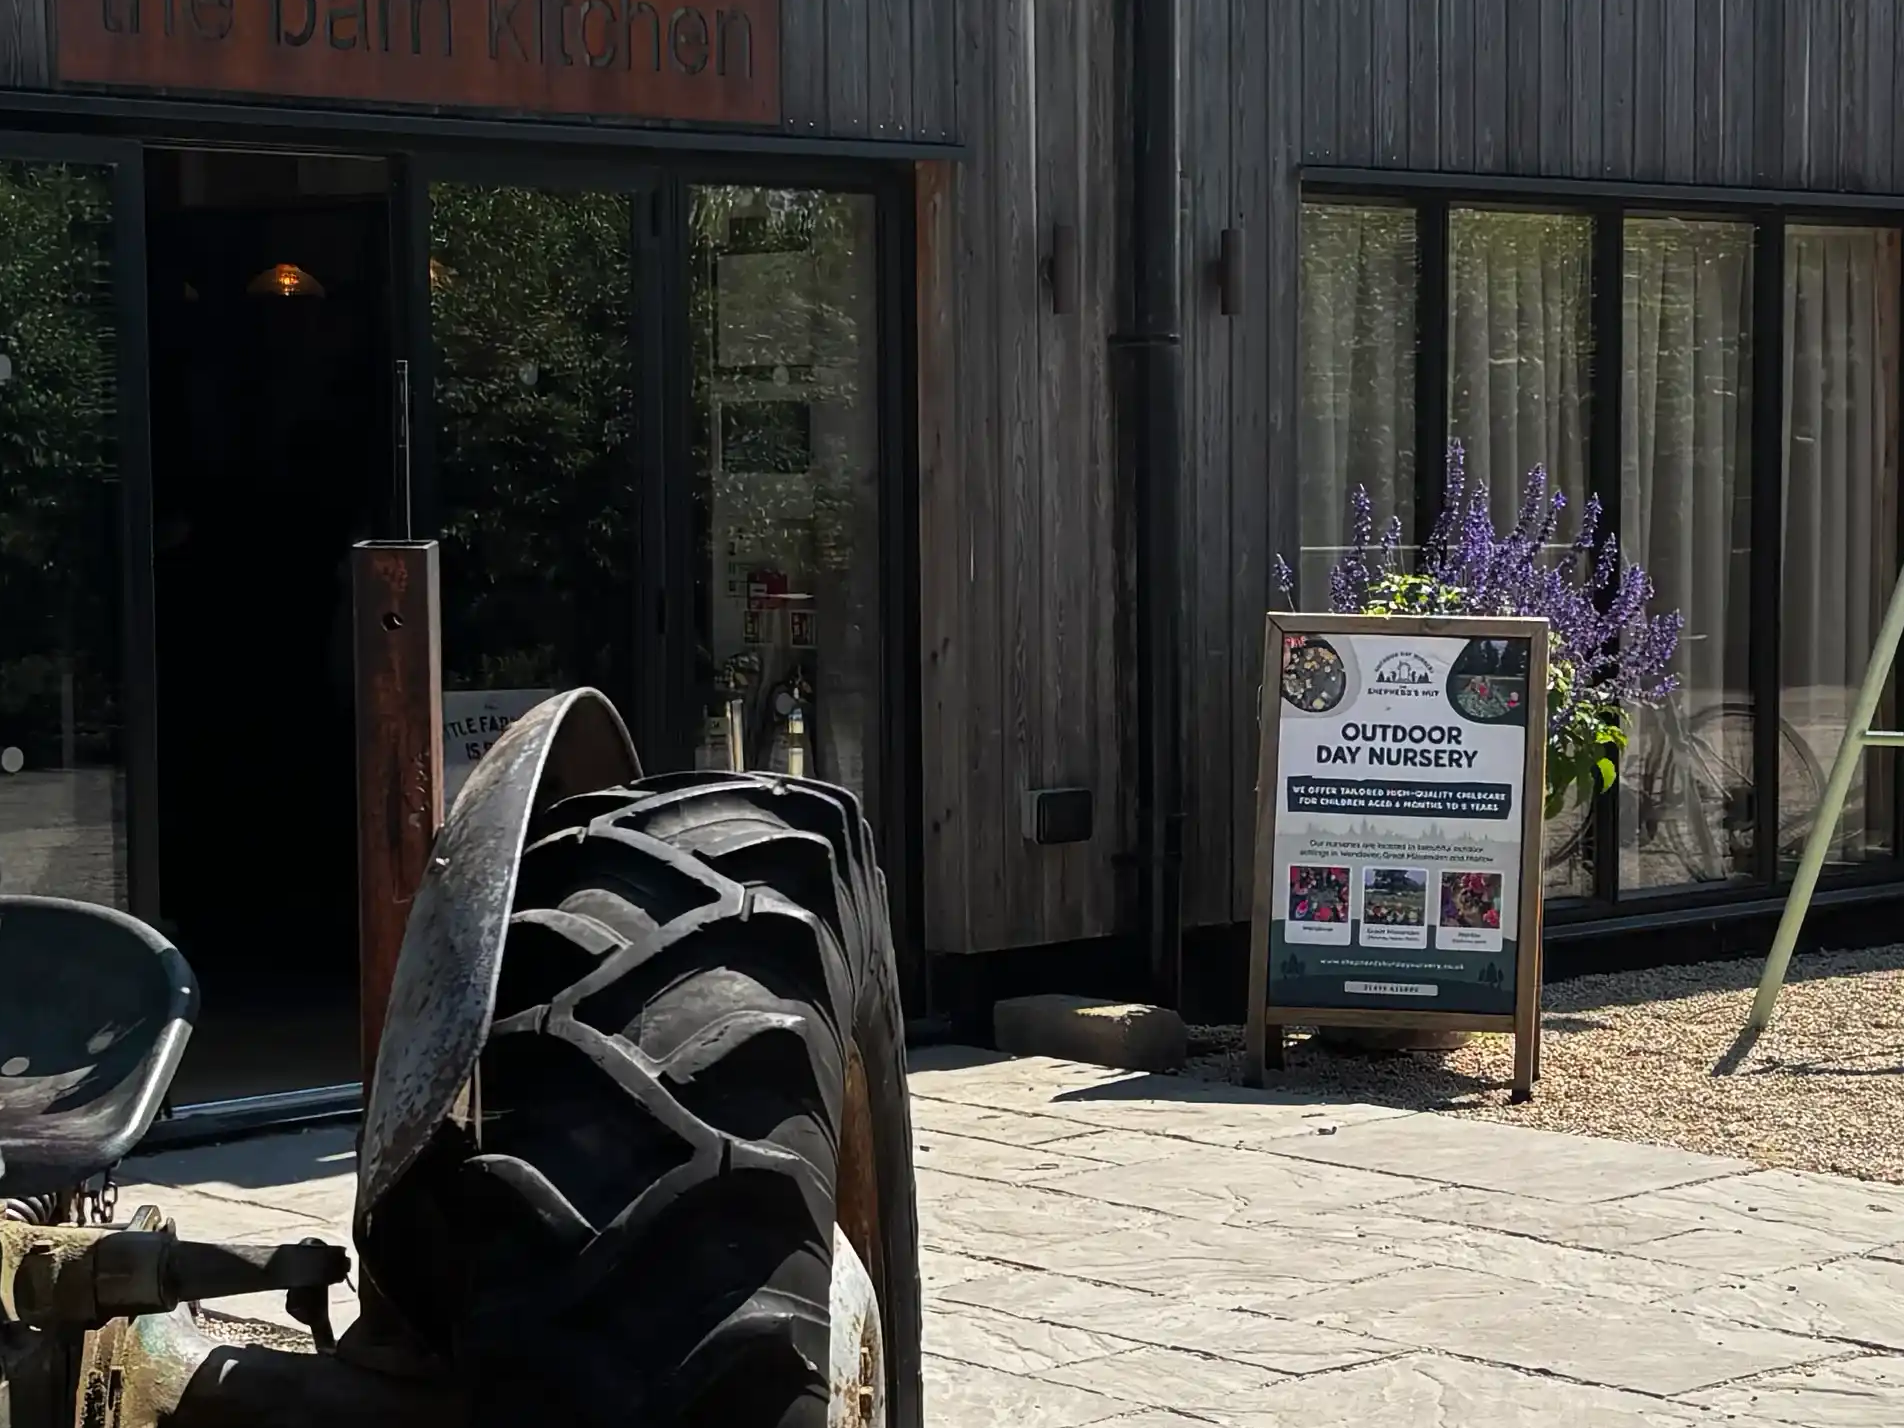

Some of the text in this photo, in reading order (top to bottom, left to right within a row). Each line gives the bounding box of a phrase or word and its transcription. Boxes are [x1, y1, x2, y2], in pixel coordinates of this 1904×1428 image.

[1342, 723, 1462, 745] OUTDOOR
[1317, 745, 1478, 768] DAY NURSERY
[1292, 785, 1507, 801] WE OFFER TAILORED HIGH-QUALITY CHILDCARE
[1299, 797, 1318, 805] FOR
[1320, 798, 1365, 807] CHILDREN
[1368, 800, 1392, 808] AGED
[1403, 801, 1443, 809] MONTHS
[1446, 802, 1459, 810] TO
[1471, 803, 1499, 812] YEARS
